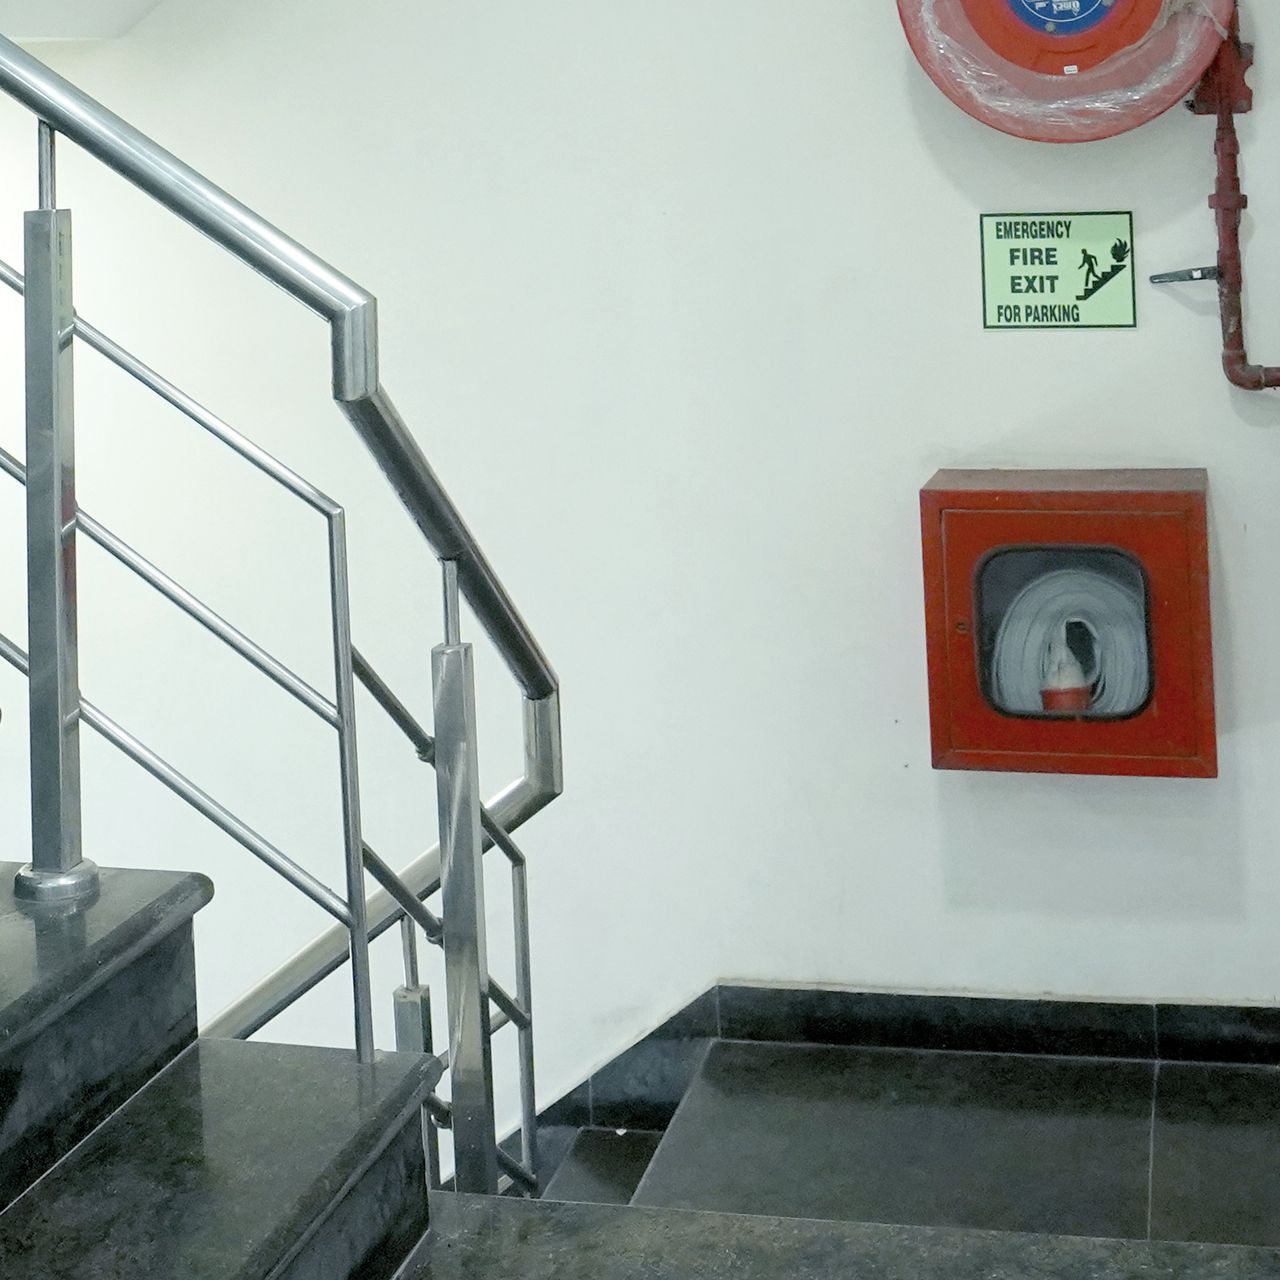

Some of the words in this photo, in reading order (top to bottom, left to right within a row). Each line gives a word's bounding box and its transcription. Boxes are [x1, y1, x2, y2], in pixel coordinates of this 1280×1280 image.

[995, 220, 1072, 240] EMERGENCY
[1009, 247, 1058, 266] FIRE
[1010, 275, 1059, 294] EXIT
[997, 304, 1021, 323] FOR
[1024, 304, 1080, 323] PARKING
